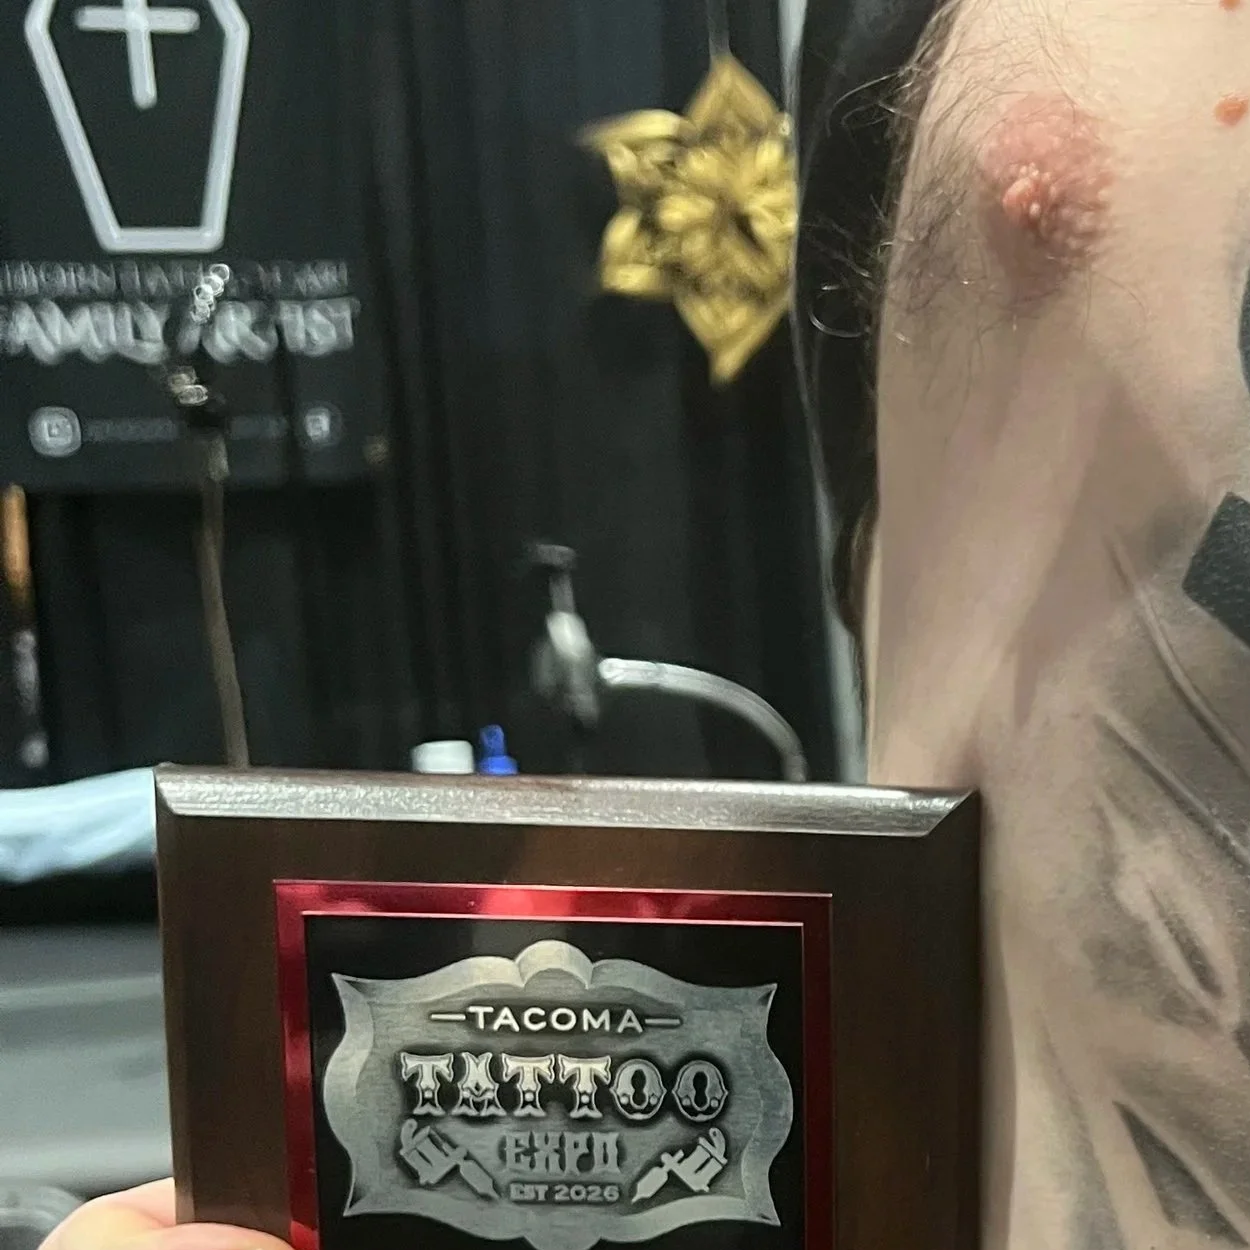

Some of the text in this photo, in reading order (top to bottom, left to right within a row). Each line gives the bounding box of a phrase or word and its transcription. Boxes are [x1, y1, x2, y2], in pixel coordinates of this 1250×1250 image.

[467, 1005, 645, 1033] TACOMA
[401, 1051, 729, 1121] TATTOO
[505, 1131, 620, 1173] EXPO
[510, 1184, 620, 1202] EST 2026
